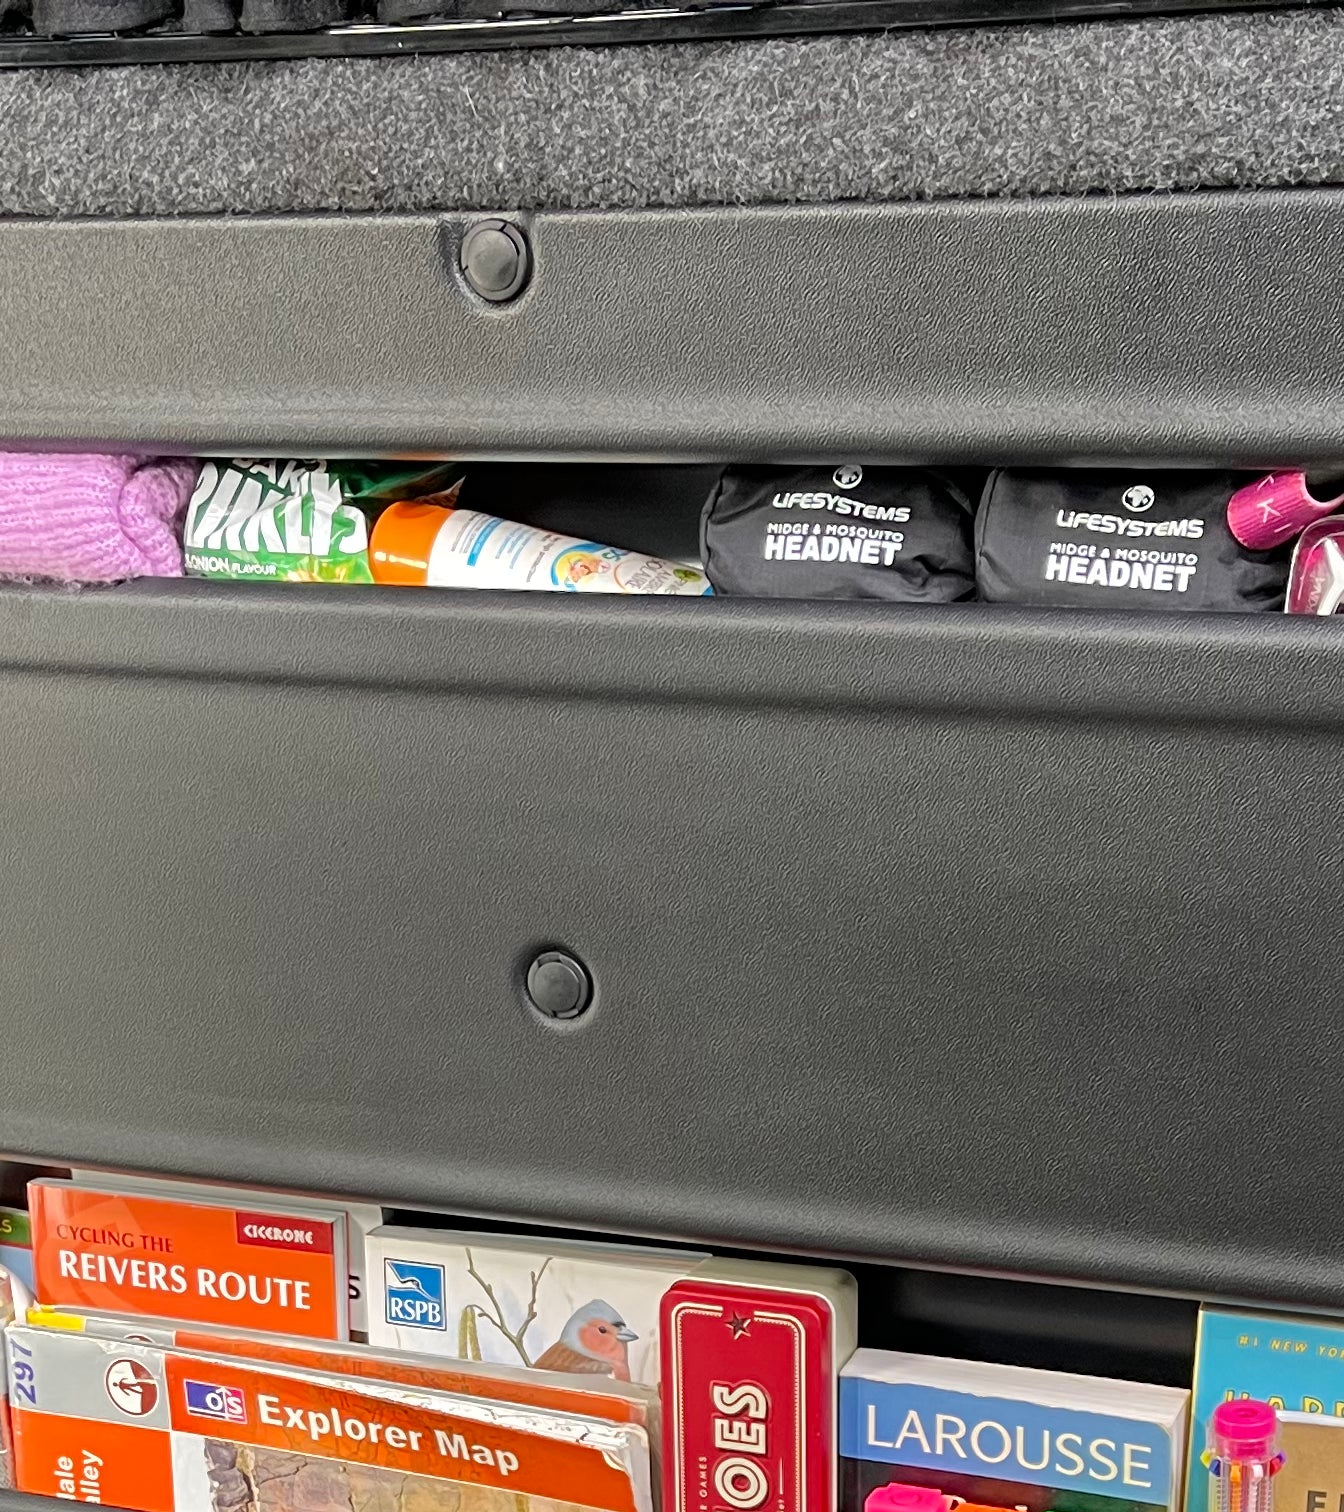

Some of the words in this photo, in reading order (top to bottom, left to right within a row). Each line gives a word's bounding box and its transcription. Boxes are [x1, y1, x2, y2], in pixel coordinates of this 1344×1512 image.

[767, 523, 810, 535] MIDGE
[812, 524, 821, 535] &
[825, 524, 904, 542] MOSQUITO
[764, 535, 903, 566] HEADNET
[1050, 542, 1096, 557] MIDGE
[1100, 548, 1110, 558] &
[1115, 549, 1198, 566] MOSQUITO
[1045, 554, 1197, 592] HEADNET
[56, 1223, 135, 1249] CYCLING
[139, 1234, 174, 1253] THE
[243, 1224, 314, 1245] CICERONE
[59, 1249, 188, 1295] REIVERS
[197, 1267, 312, 1310] ROUTE
[391, 1297, 442, 1324] RSPB
[1271, 1339, 1308, 1354] NEW
[11, 1337, 37, 1404] 297
[206, 1390, 244, 1416] OS
[258, 1394, 424, 1452] Explorer
[435, 1429, 520, 1476] Map
[867, 1404, 1153, 1488] LAROUSSE
[699, 1456, 708, 1498] GAMES
